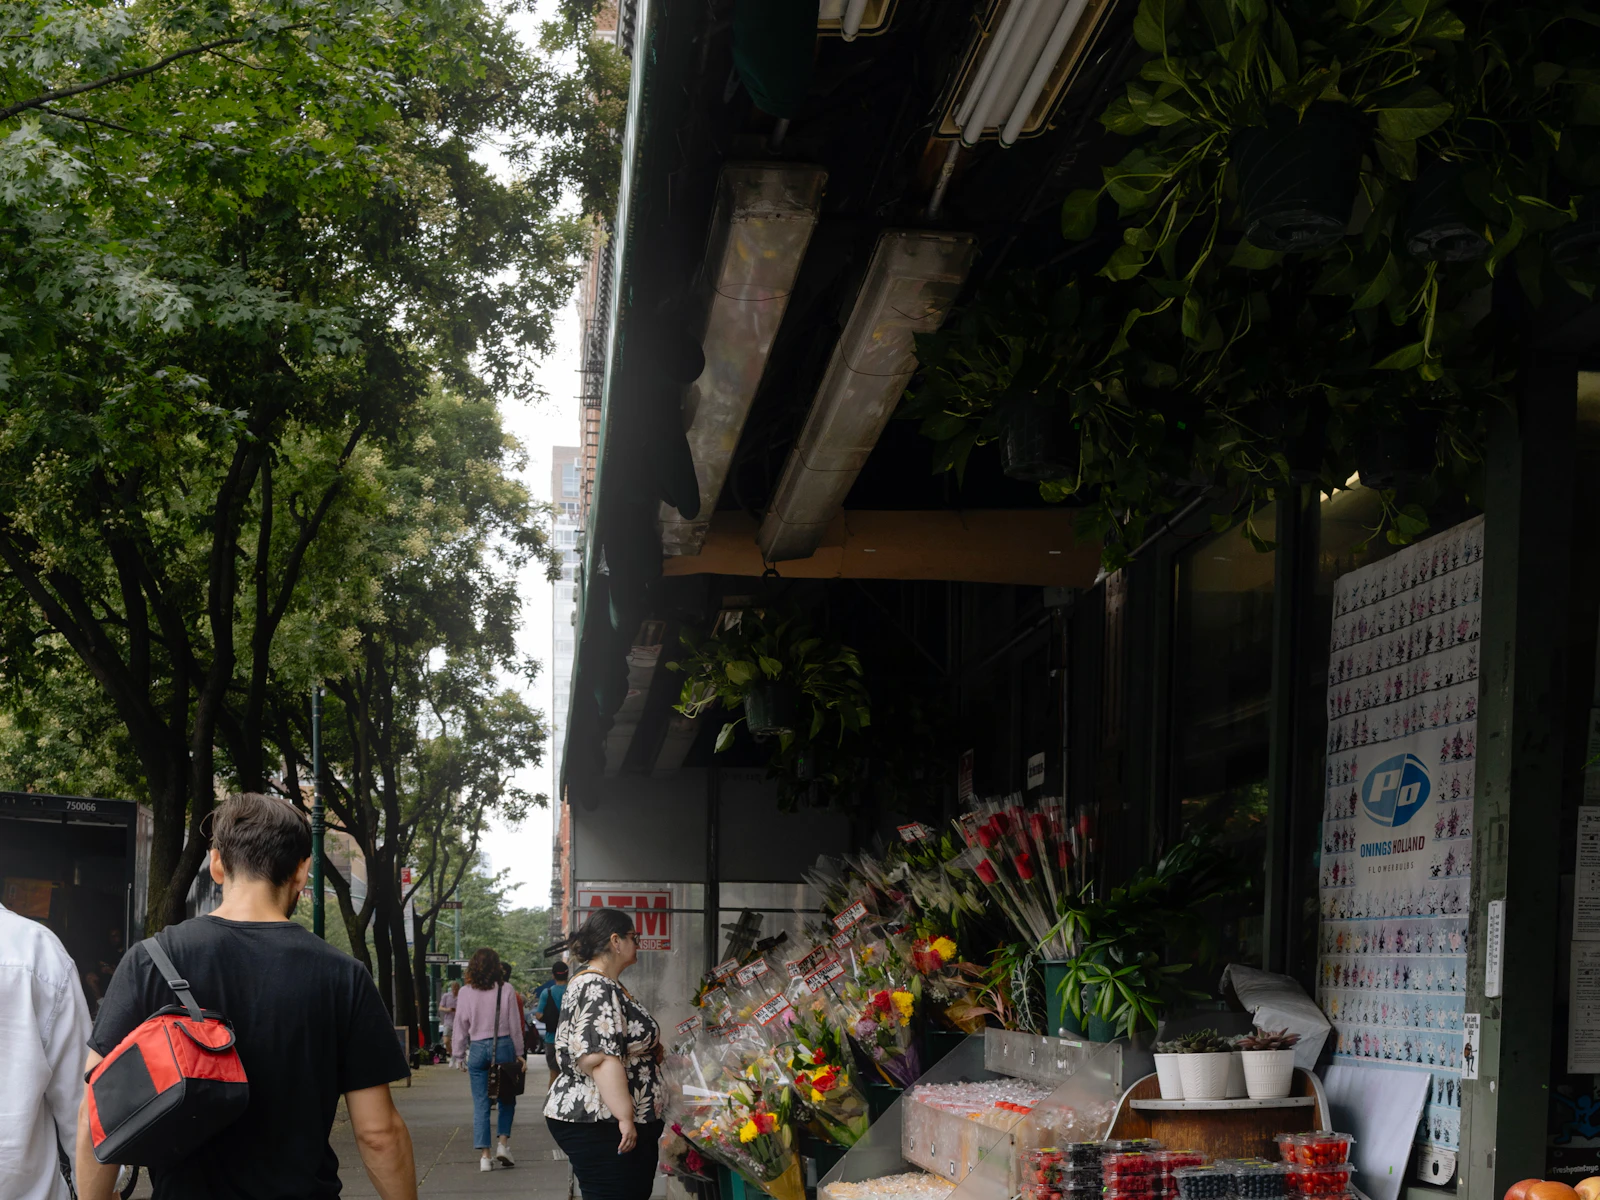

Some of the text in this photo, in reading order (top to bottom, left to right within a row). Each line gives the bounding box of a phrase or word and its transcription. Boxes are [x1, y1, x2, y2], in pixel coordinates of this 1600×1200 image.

[66, 801, 96, 812] 750066
[1368, 861, 1414, 874] FLOWERBULBS
[638, 940, 662, 950] NSIDE
